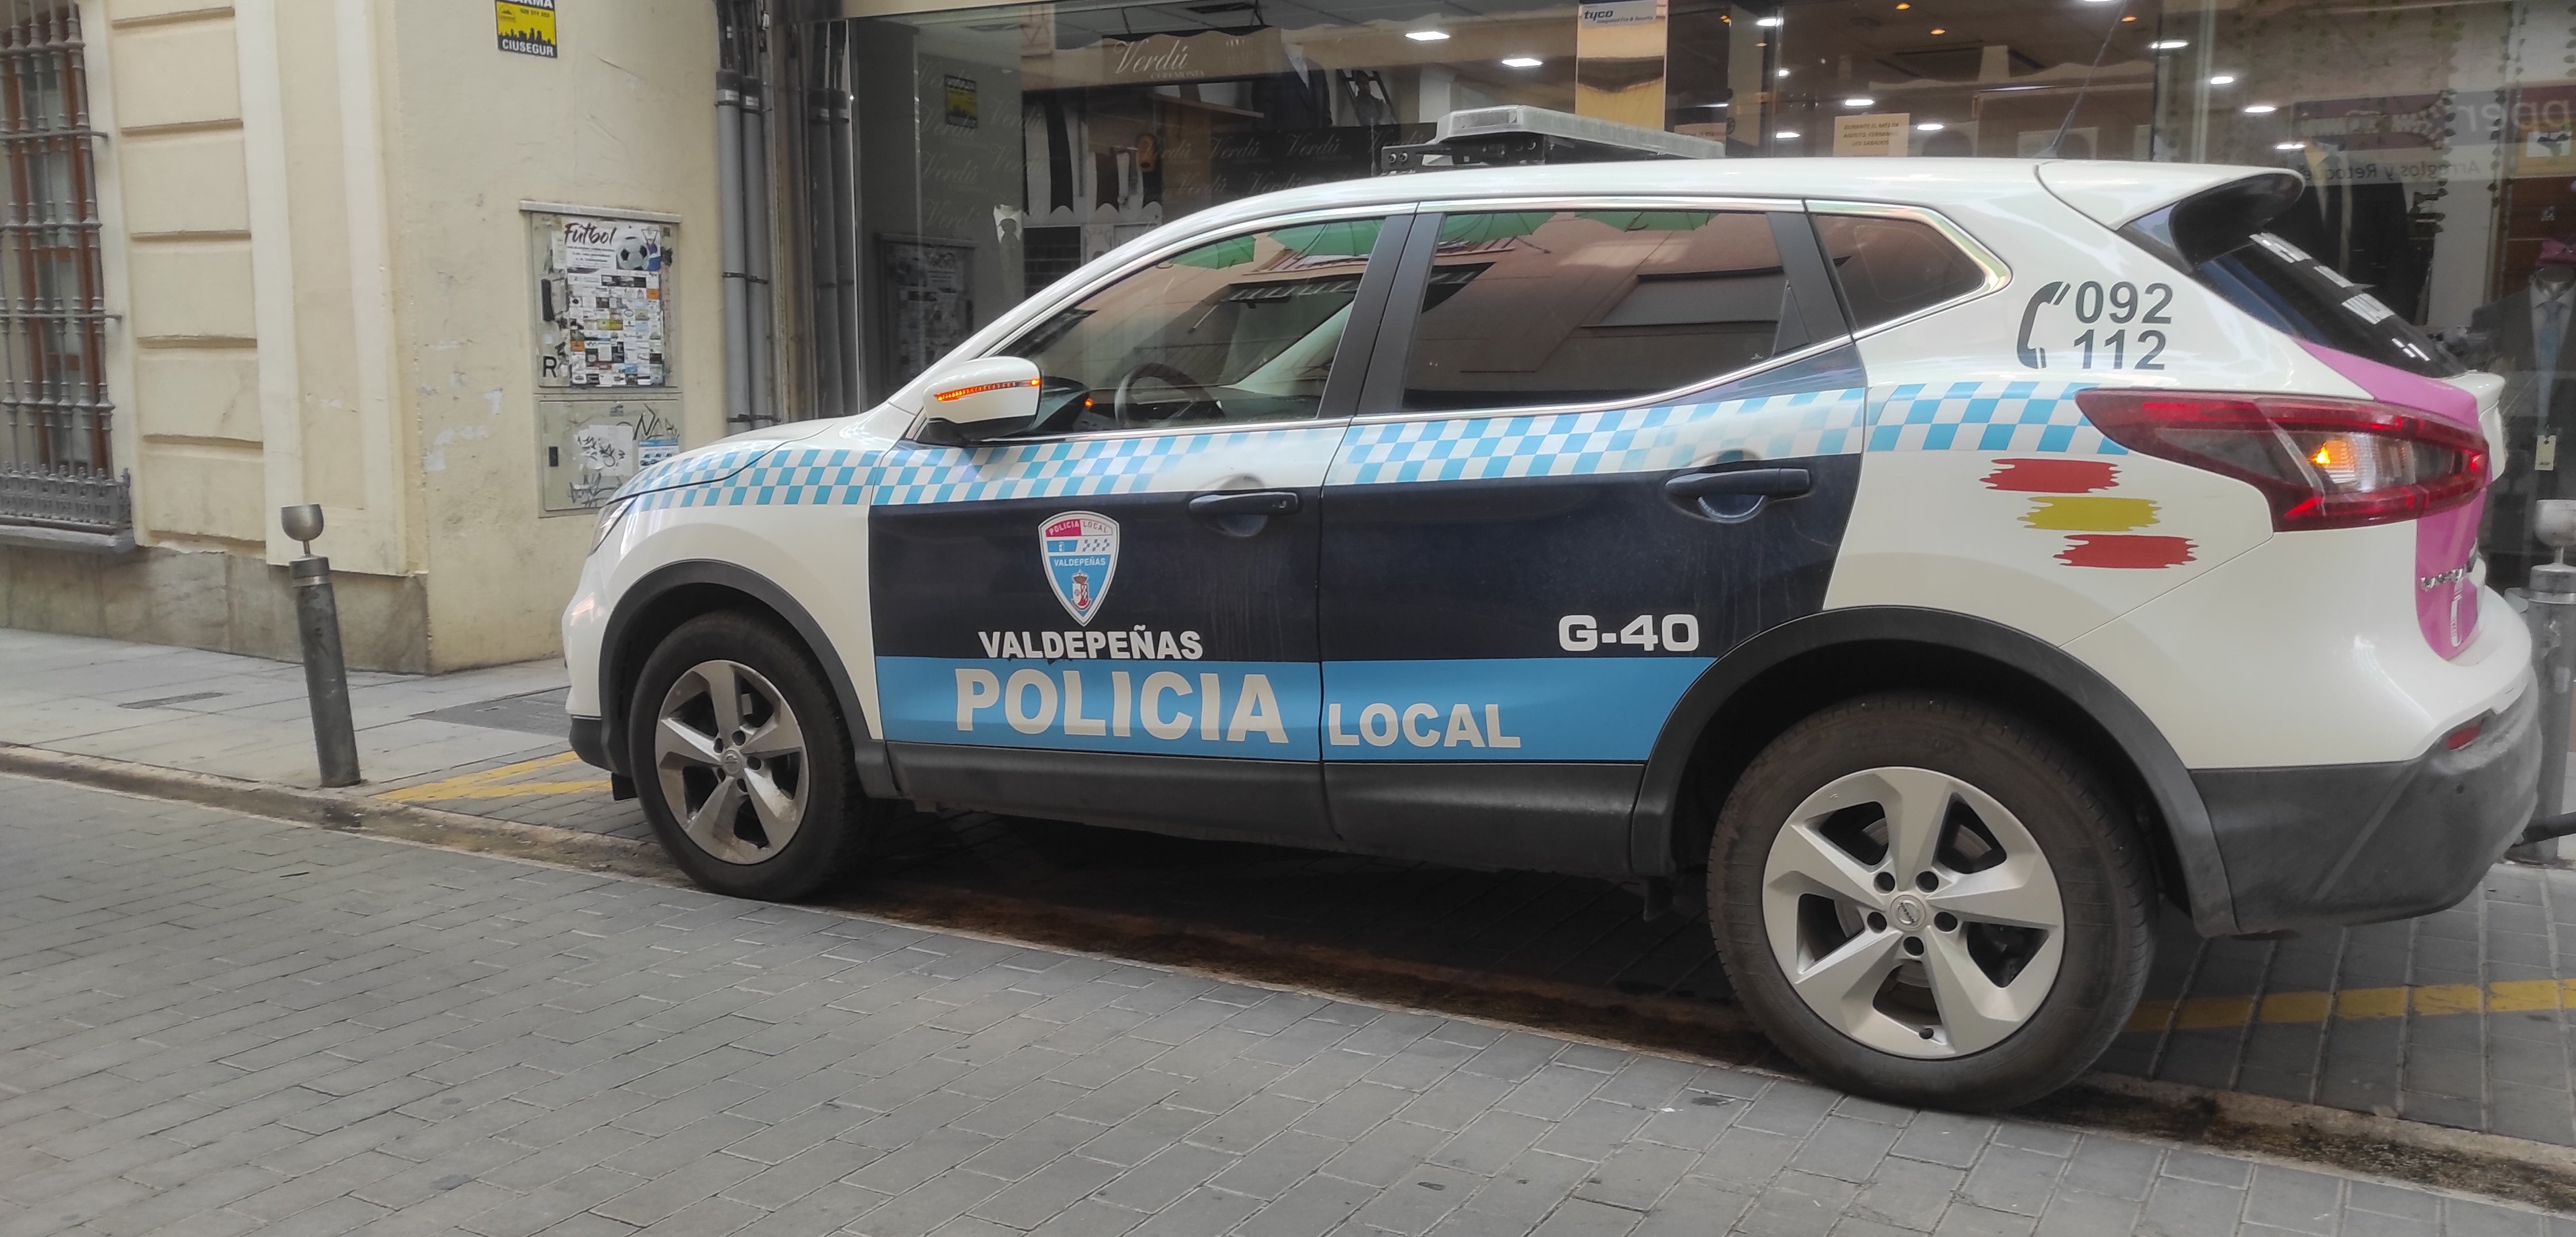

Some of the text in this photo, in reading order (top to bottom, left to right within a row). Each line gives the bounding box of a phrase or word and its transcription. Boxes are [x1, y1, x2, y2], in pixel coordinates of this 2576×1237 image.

[1584, 11, 1614, 21] tyco
[502, 38, 554, 56] CIUSEGUR
[1113, 37, 1189, 74] Verdú
[1150, 69, 1204, 79] CEREMONIA
[2075, 280, 2173, 324] 092
[2073, 329, 2166, 369] 112
[1048, 520, 1108, 536] POLICIA LOCAL
[1054, 556, 1106, 567] VALDEPEÑAS
[978, 624, 1203, 660] VALDEPEÑAS
[1558, 613, 1700, 651] G-40
[955, 668, 1521, 748] POLICIA LOCAL
